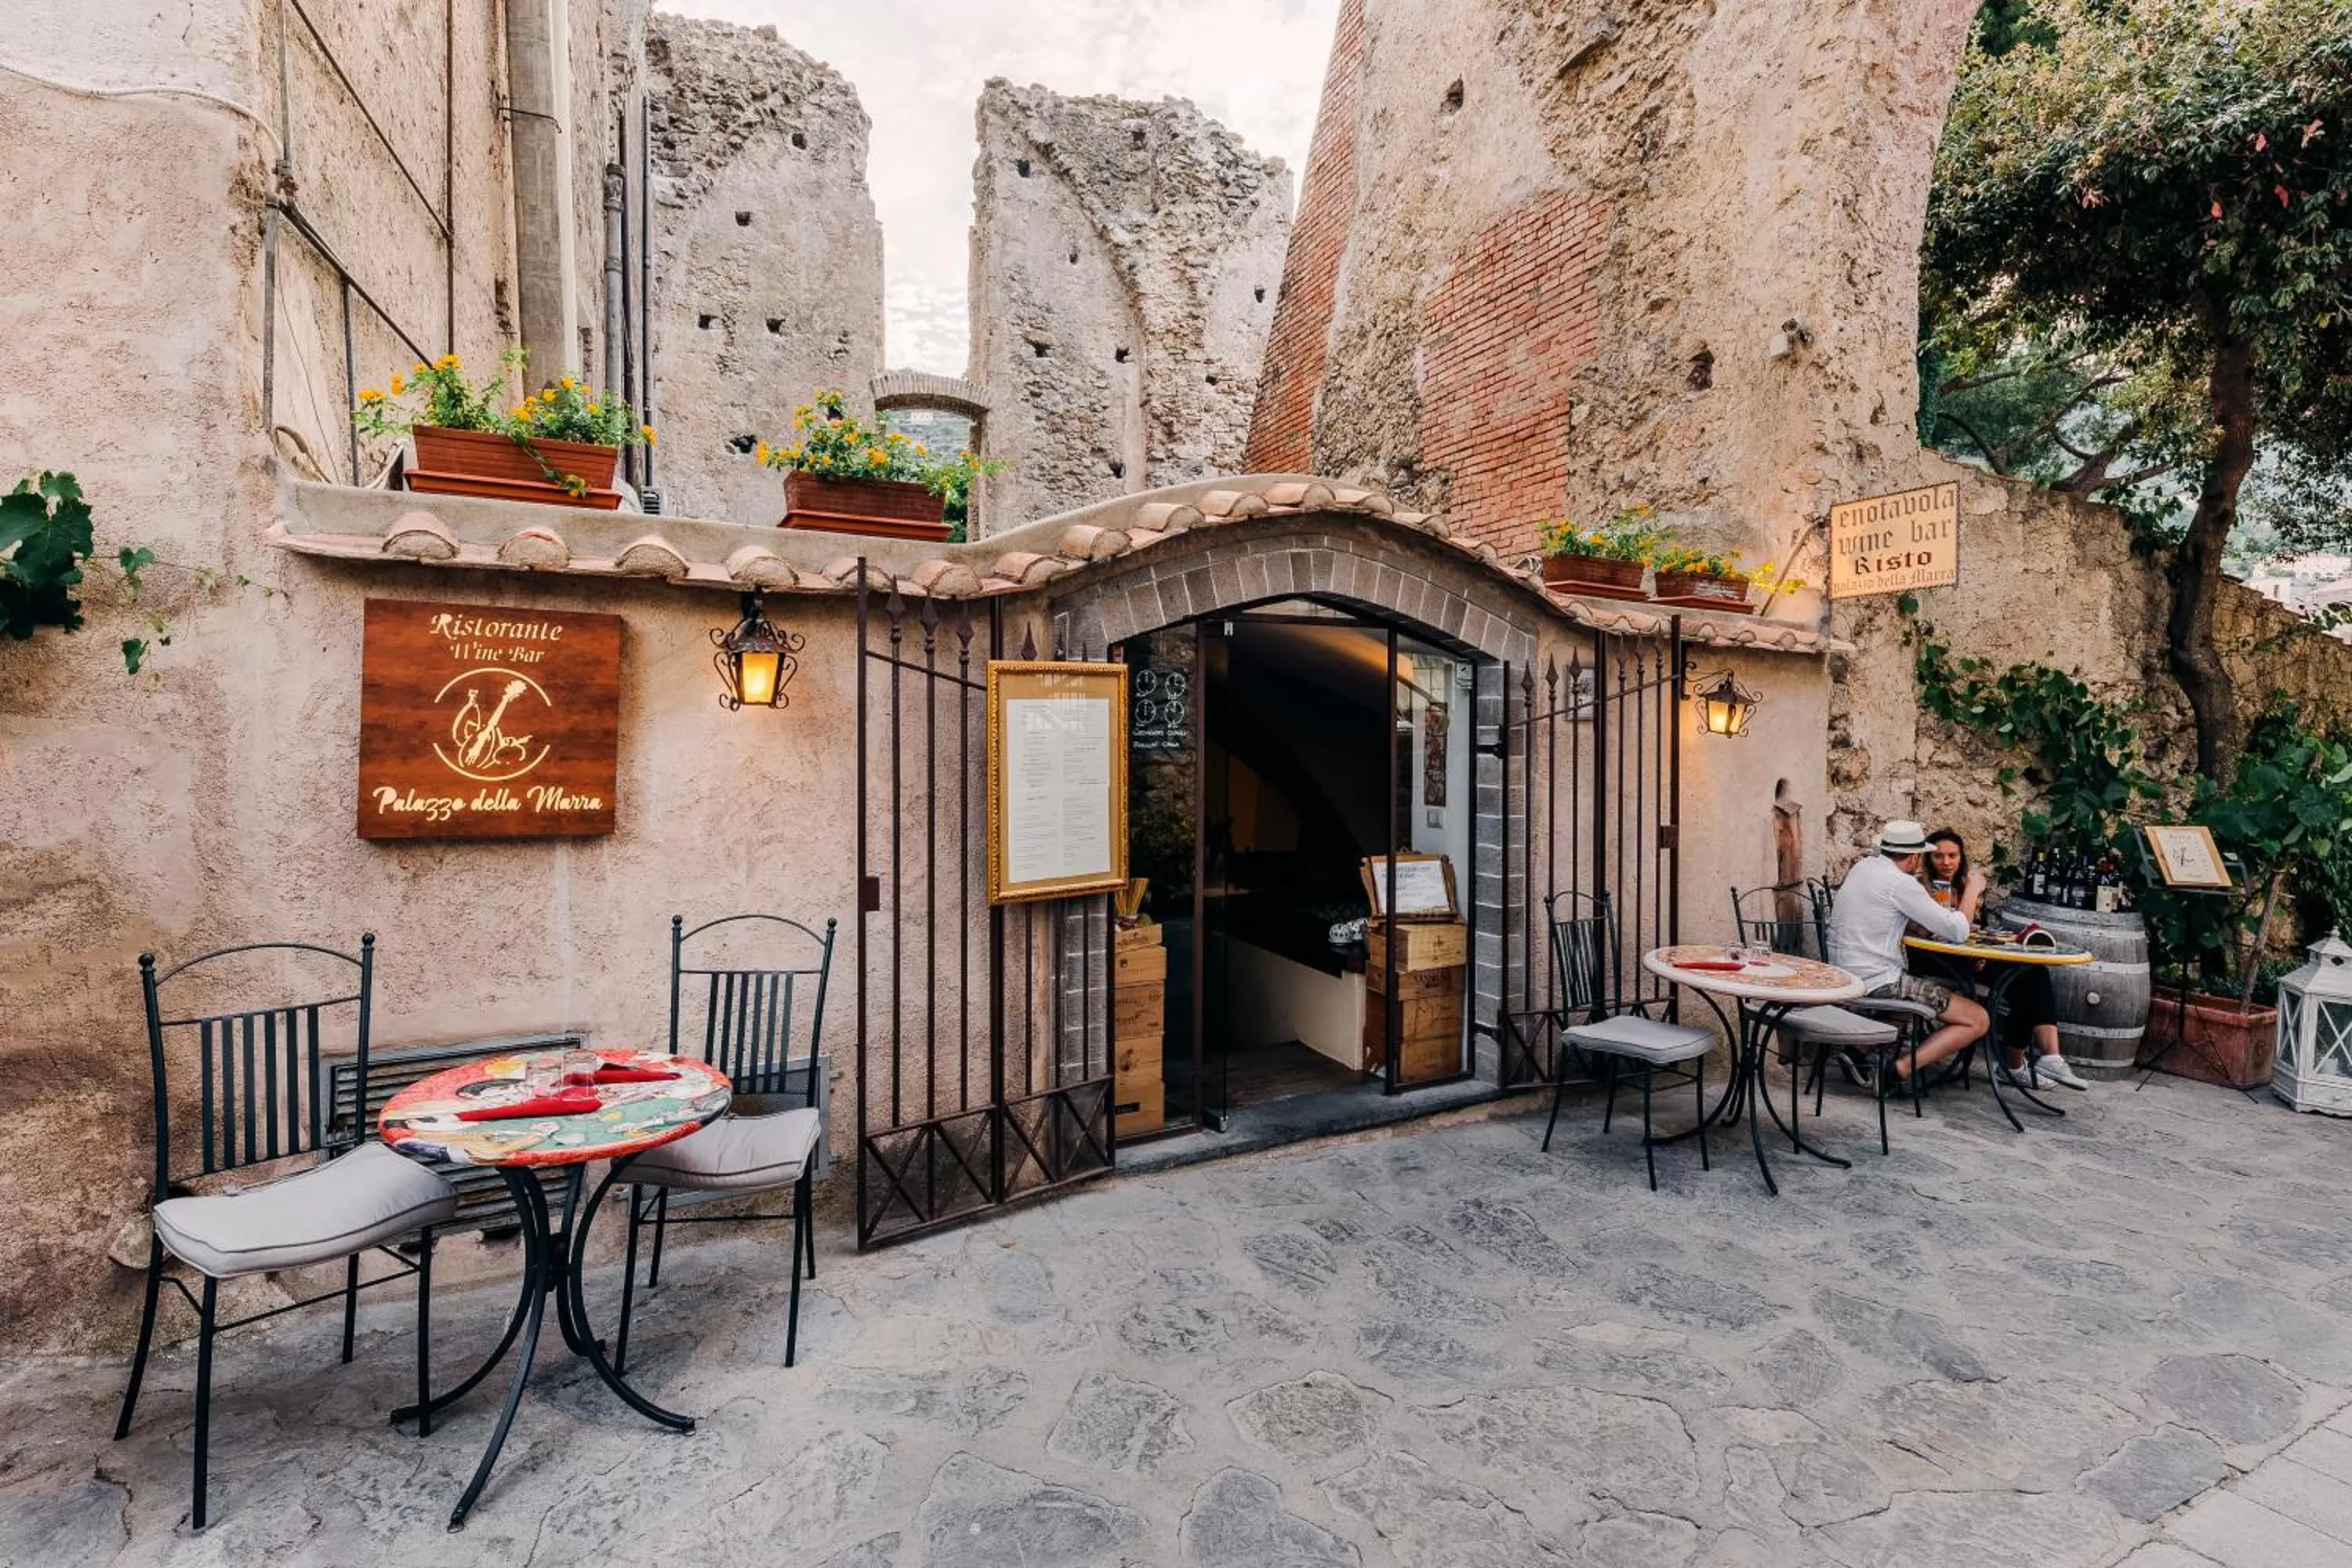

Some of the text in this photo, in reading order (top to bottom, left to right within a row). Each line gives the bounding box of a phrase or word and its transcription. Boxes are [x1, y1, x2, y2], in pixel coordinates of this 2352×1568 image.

[1839, 487, 1955, 528] enotavola
[1838, 518, 1951, 556] wine bar
[1855, 550, 1933, 575] Risto
[430, 613, 563, 641] Ristorante
[450, 642, 545, 663] Wine Bar
[372, 786, 603, 821] Palazzo della Marra
